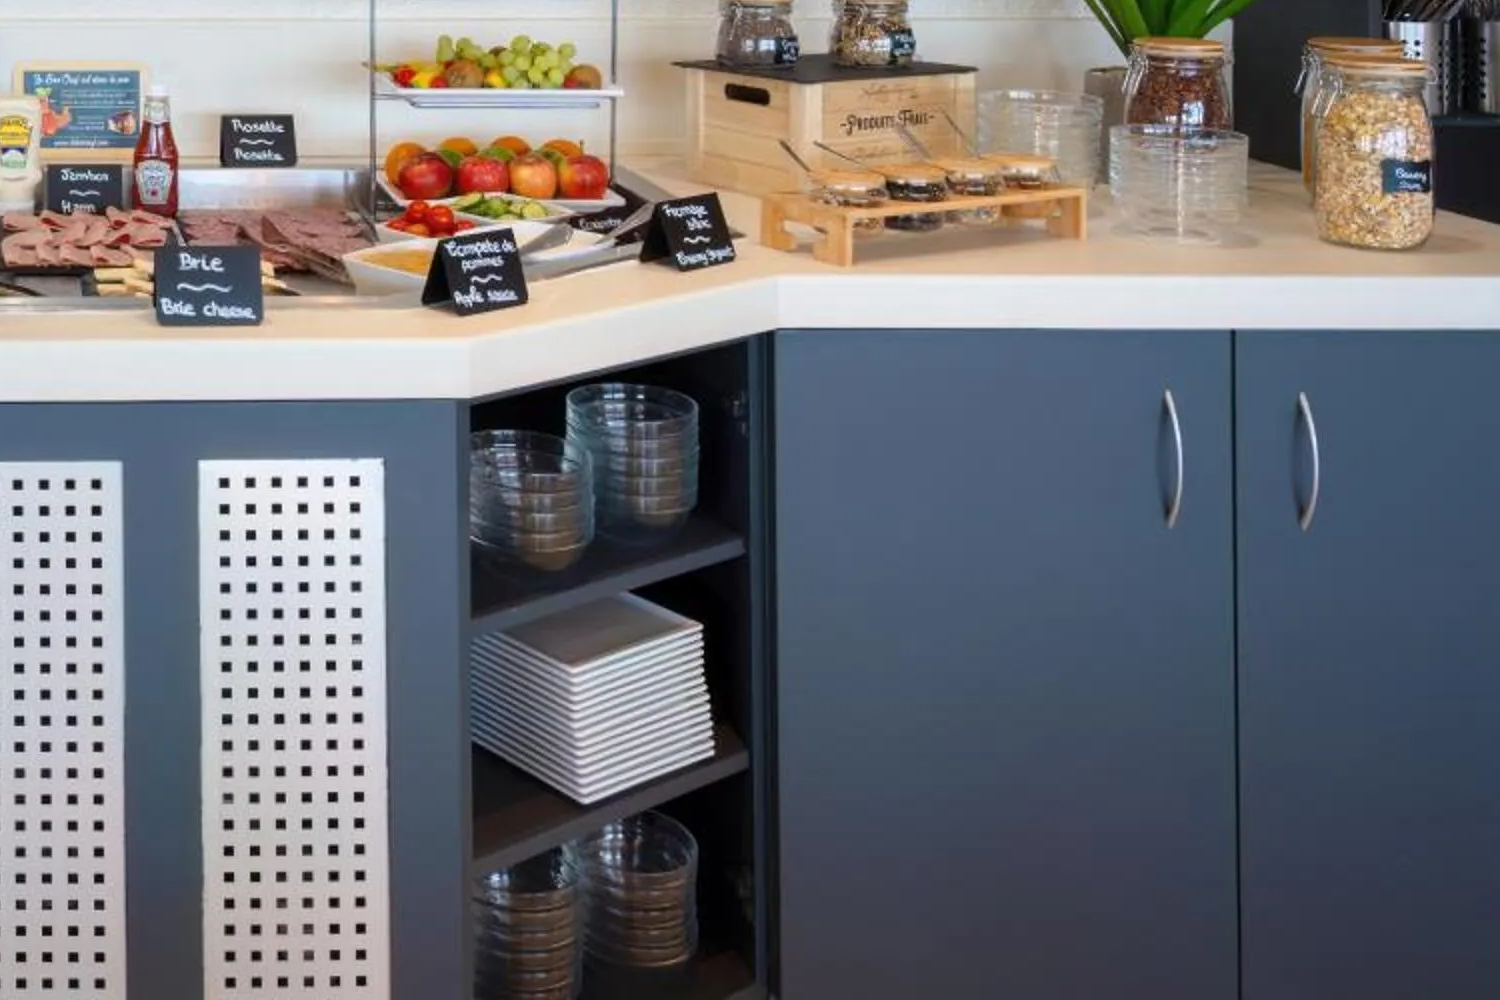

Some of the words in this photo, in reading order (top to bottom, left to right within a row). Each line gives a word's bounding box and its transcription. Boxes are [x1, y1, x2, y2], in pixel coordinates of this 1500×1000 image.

[179, 252, 226, 273] Brie
[160, 297, 197, 317] Brie
[202, 300, 257, 320] cheese
